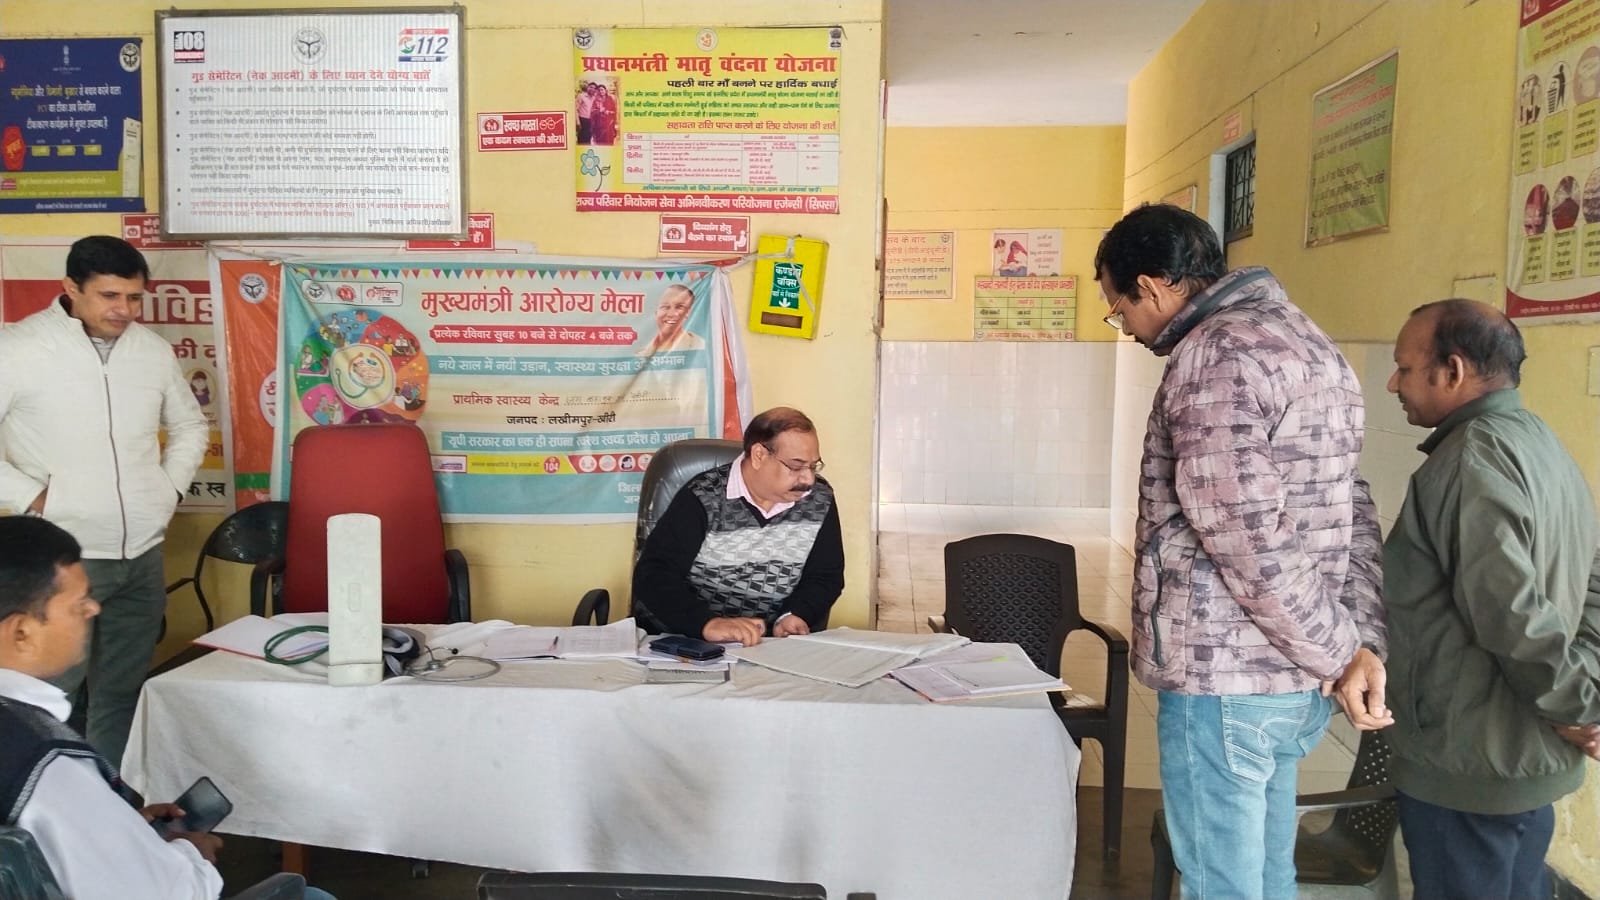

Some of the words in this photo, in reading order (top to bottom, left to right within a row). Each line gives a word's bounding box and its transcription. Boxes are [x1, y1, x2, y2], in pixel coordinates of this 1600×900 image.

[174, 31, 204, 51] 108
[417, 36, 449, 54] 112
[581, 52, 670, 72] प्रधानमंत्री
[675, 56, 712, 76] मातृ
[718, 52, 768, 72] वंदना
[774, 53, 838, 72] योजना
[667, 78, 695, 87] पहली
[732, 78, 756, 87] बनने
[775, 78, 808, 88] हार्दिक
[811, 78, 838, 88] बधाई
[667, 121, 695, 129] सहायता
[596, 194, 622, 207] परिवार
[624, 194, 658, 207] नियोजन
[659, 195, 676, 207] सेवा
[732, 195, 772, 209] परियोजना
[421, 285, 514, 318] मुख्यमंत्री
[520, 287, 595, 314] आरोग्य
[600, 287, 646, 314] मेला
[433, 327, 460, 339] प्रत्येक
[462, 327, 491, 339] रविवार
[494, 330, 515, 343] सुबह
[519, 331, 528, 339] 10
[530, 328, 546, 340] बजे
[548, 328, 557, 340] से
[559, 328, 586, 340] दोपहर
[589, 332, 596, 340] 4
[599, 328, 614, 340] बजे
[617, 331, 633, 340] तक
[438, 357, 456, 371] नये
[459, 359, 481, 371] साल
[484, 356, 494, 371] में
[496, 356, 517, 371] नयी
[554, 361, 596, 372] स्वास्थ्य
[600, 361, 631, 375] सुरक्षा
[452, 391, 493, 405] प्राथमिक
[496, 395, 532, 406] स्वास्थ्य
[538, 392, 560, 406] केन्द्र
[506, 415, 538, 425] जनपद
[447, 433, 466, 449] यूपी
[468, 436, 501, 447] सरकार
[502, 437, 516, 447] का
[517, 438, 534, 447] एक
[535, 434, 547, 448] ही
[548, 437, 574, 447] सपना
[626, 431, 650, 446] प्रदेश
[650, 430, 661, 443] हो
[544, 462, 559, 471] 104
